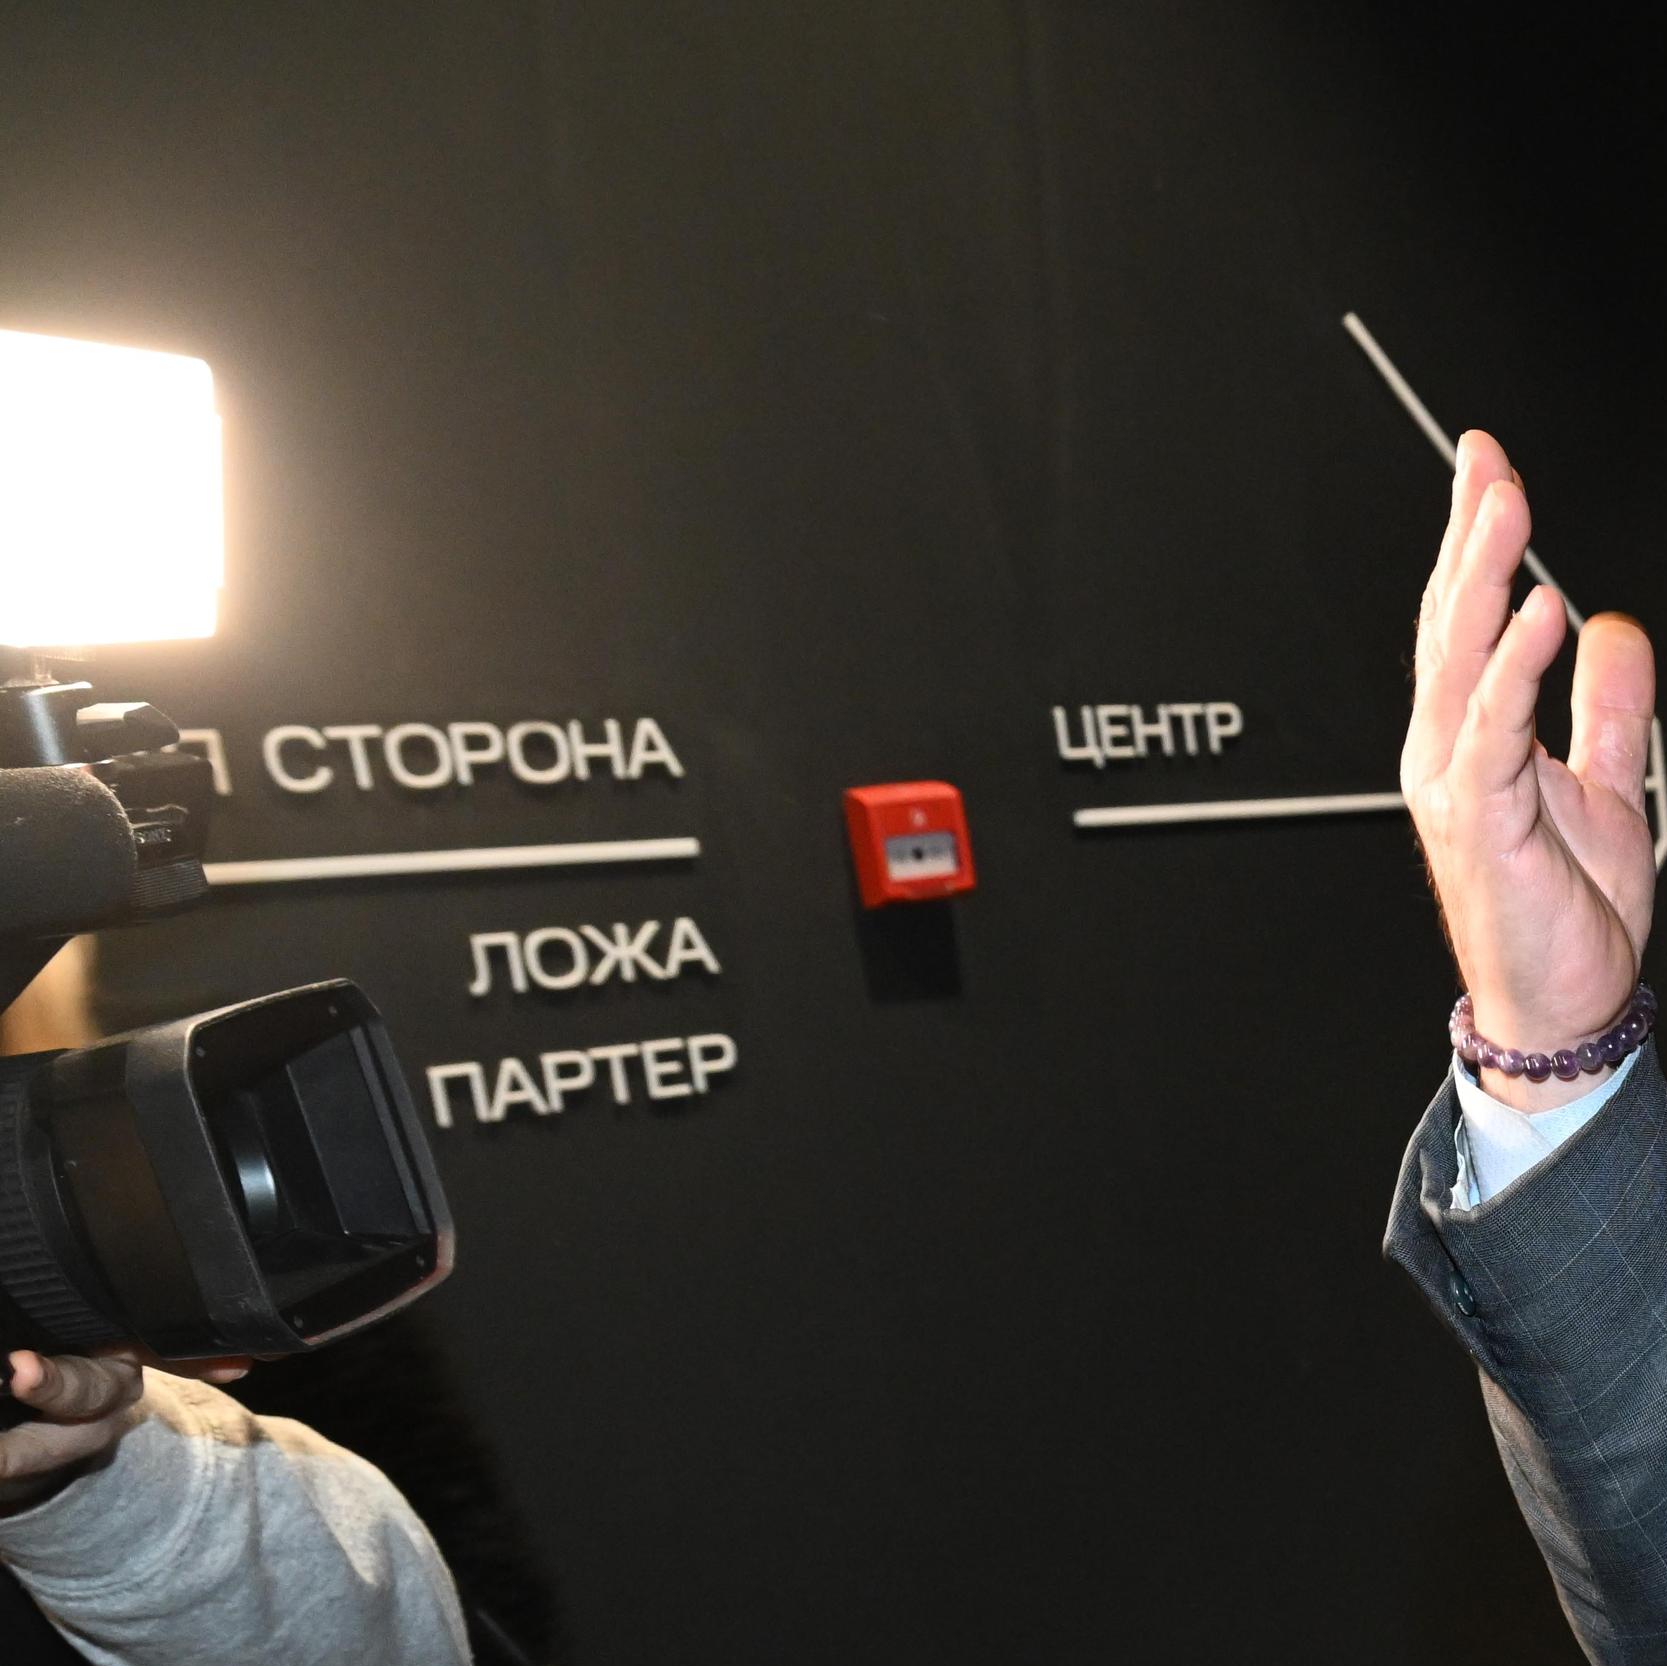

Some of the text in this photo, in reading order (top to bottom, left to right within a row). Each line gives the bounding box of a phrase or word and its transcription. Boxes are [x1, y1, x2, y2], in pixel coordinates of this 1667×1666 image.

[262, 717, 684, 793] СТОРОНА
[1052, 702, 1243, 768] ЦЕНТР
[469, 916, 721, 996] ЛОЖА
[426, 1033, 737, 1127] ПАРТЕР
